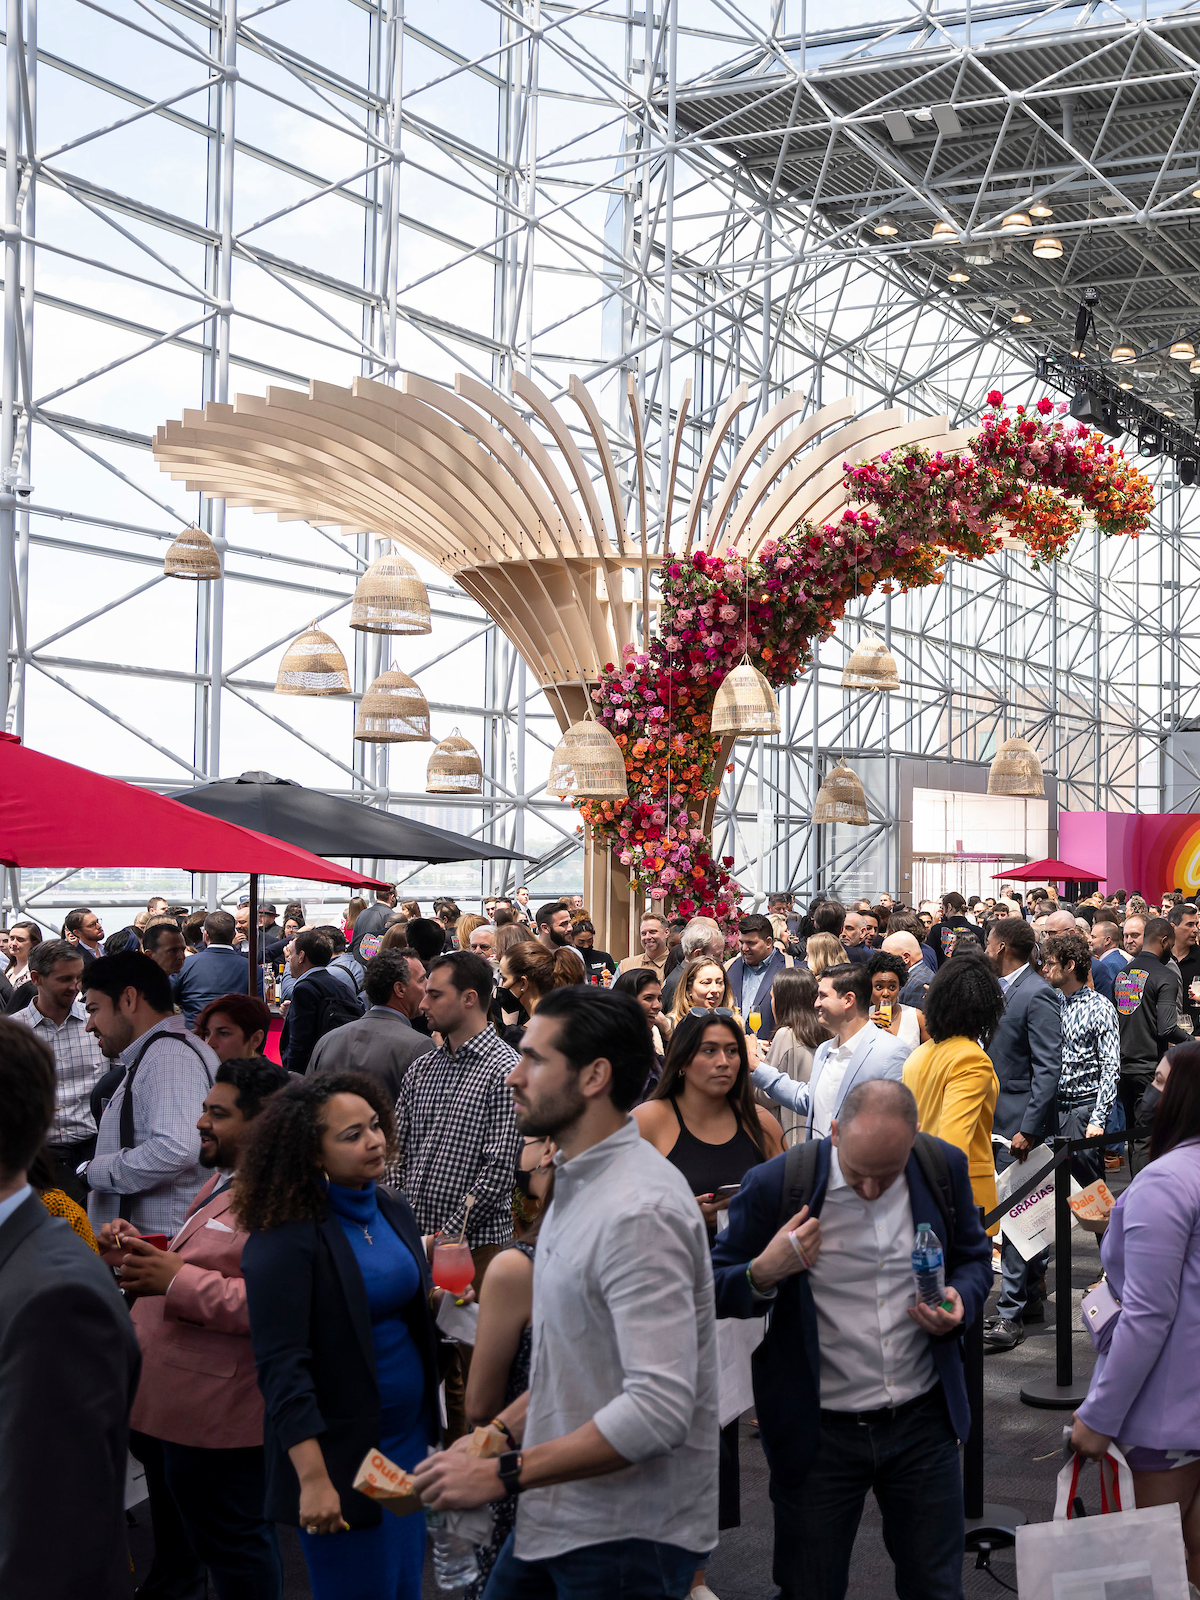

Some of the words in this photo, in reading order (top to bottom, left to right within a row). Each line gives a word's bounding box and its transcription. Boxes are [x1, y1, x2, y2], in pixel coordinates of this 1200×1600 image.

[1009, 1184, 1055, 1218] GRACIAS
[1071, 1194, 1096, 1211] Dale
[1097, 1184, 1113, 1206] Que
[371, 1455, 399, 1483] Que
